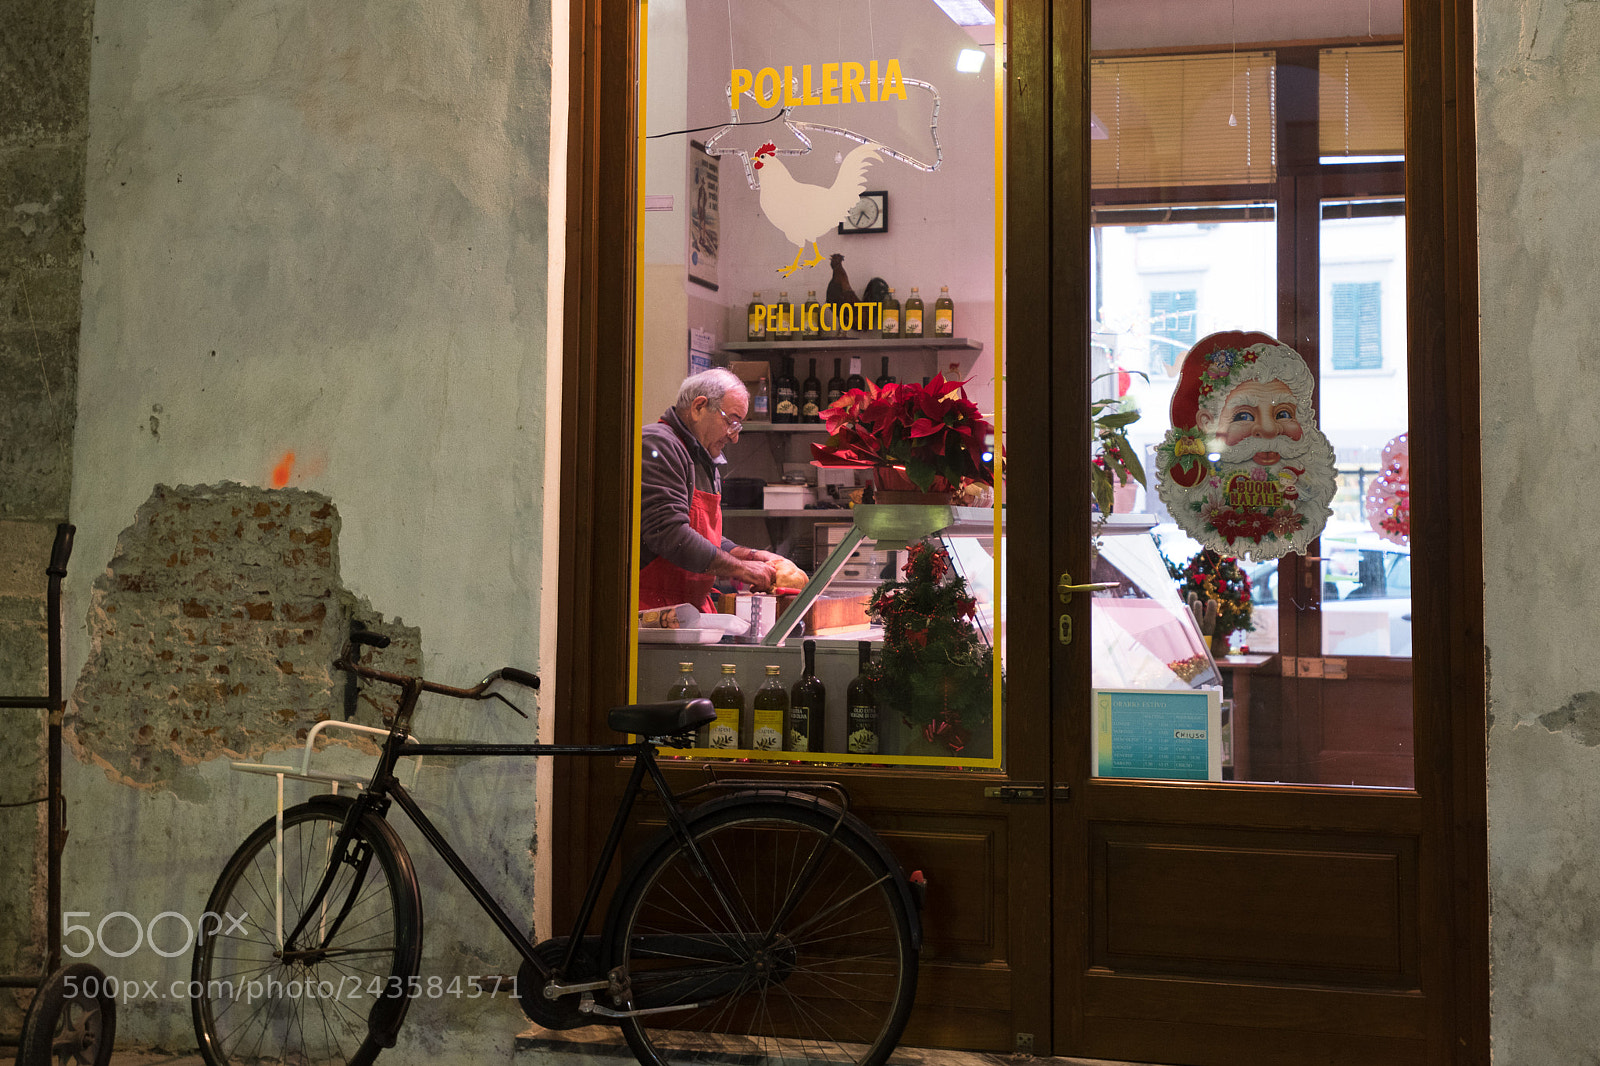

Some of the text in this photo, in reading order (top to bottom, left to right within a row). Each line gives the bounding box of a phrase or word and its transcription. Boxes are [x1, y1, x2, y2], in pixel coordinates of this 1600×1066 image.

[731, 59, 908, 110] POLLERIA
[754, 301, 883, 332] PELLICCIOTTI
[1237, 481, 1271, 494] BUON
[1230, 493, 1281, 506] NATALE
[1113, 700, 1140, 708] ORARIO
[1175, 731, 1205, 739] CHIUSO
